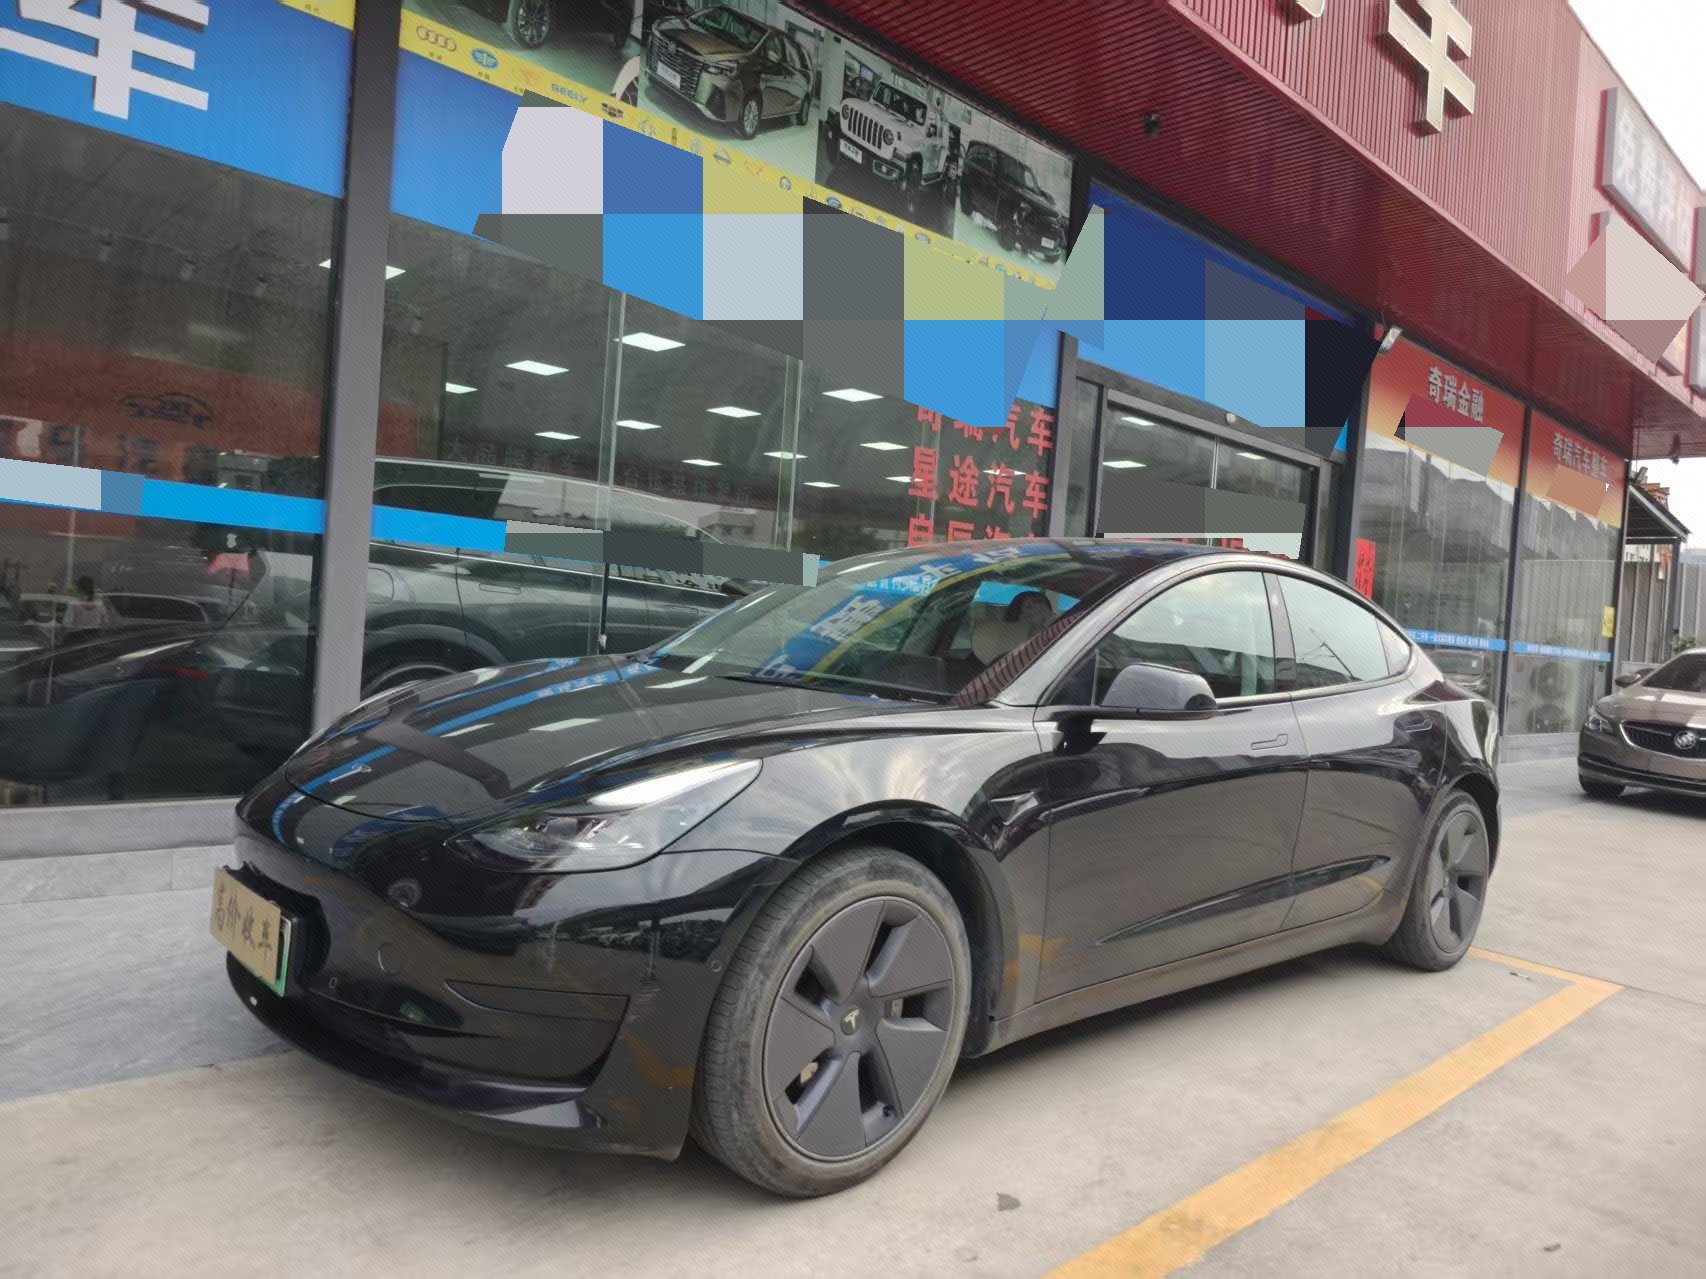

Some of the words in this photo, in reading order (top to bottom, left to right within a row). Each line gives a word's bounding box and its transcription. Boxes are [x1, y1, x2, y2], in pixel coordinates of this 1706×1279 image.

[1428, 366, 1484, 424] 奇瑞金融
[907, 446, 1050, 520] 星途汽车
